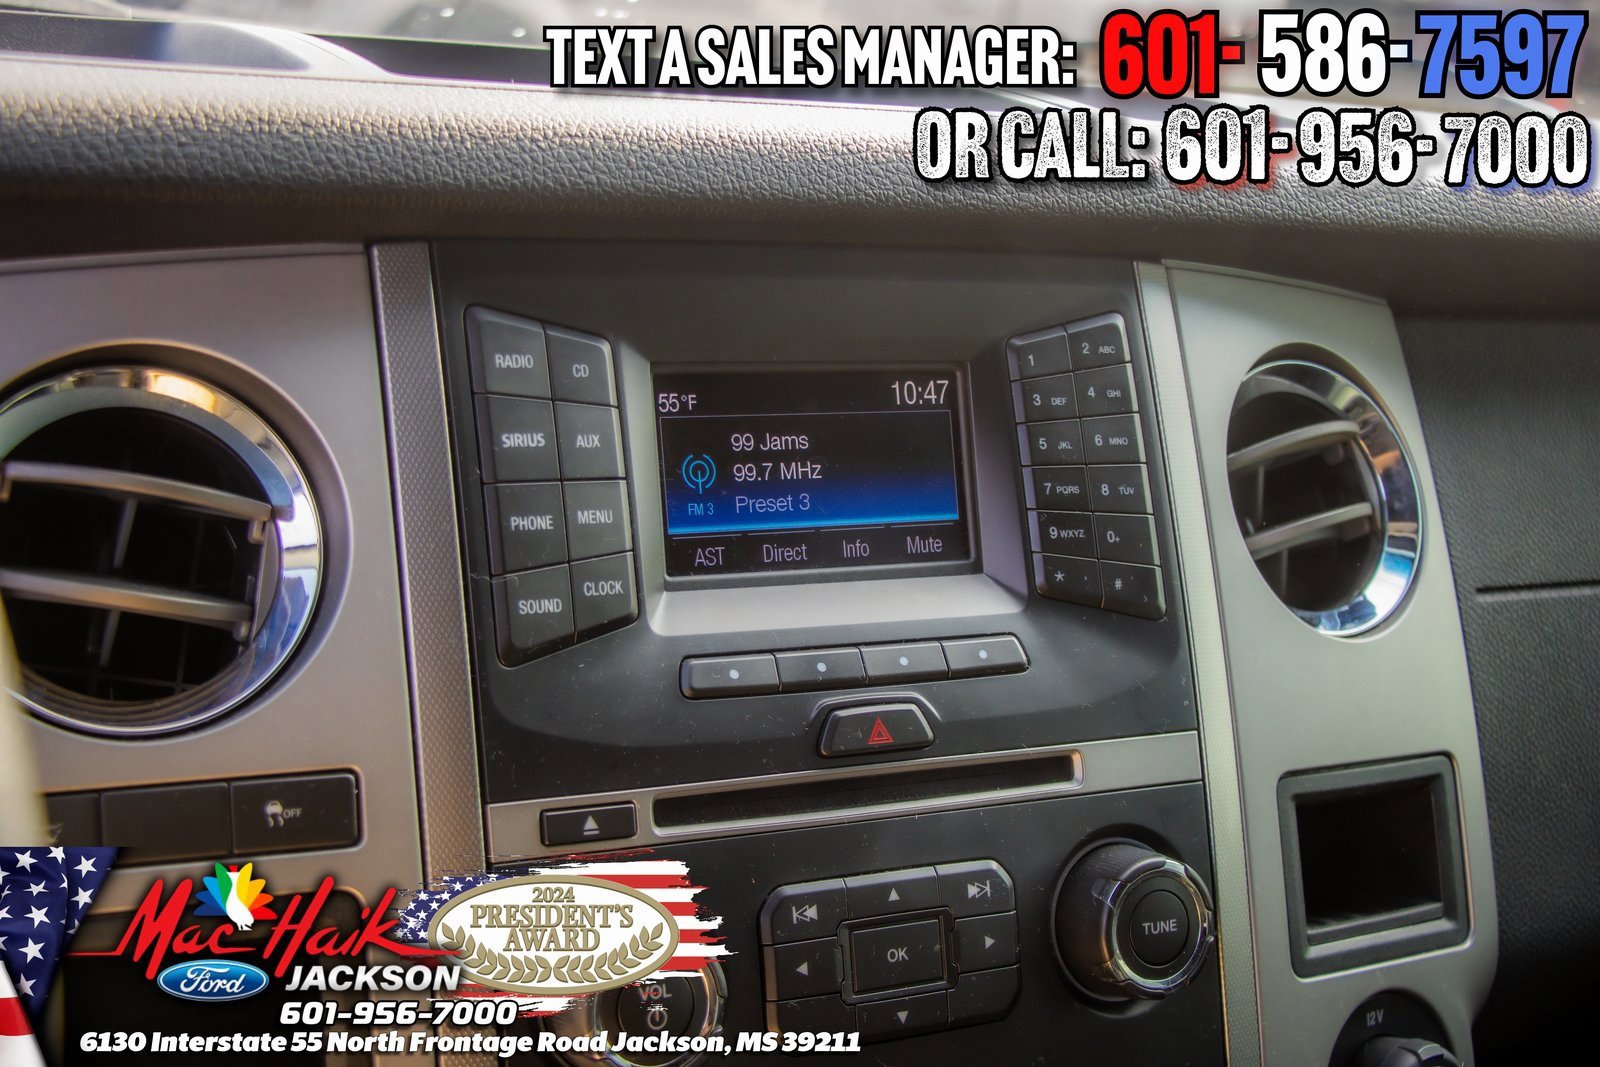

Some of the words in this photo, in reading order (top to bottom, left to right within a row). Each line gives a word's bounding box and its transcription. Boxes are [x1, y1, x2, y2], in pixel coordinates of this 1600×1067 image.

[1082, 342, 1090, 354] 2
[1098, 345, 1116, 354] ABC
[494, 352, 534, 370] RADIO
[1028, 355, 1035, 366] 1
[572, 364, 590, 379] CD
[891, 378, 950, 406] 10:47
[1032, 394, 1042, 406] 3
[1051, 396, 1068, 406] DEF
[1087, 386, 1096, 399] 4
[1106, 388, 1122, 398] GHI
[658, 392, 698, 413] 55°F
[501, 432, 546, 449] SIRIUS
[576, 434, 601, 449] AUX
[731, 433, 755, 453] 99
[759, 432, 810, 452] Jams
[1039, 438, 1048, 450] 5
[1058, 440, 1073, 450] JKL
[1094, 434, 1104, 447] 6
[1108, 436, 1129, 446] MNO
[733, 462, 773, 482] 99.7
[780, 461, 823, 481] MHz
[1044, 482, 1052, 495] 7
[1056, 485, 1080, 496] PQRS
[1100, 484, 1110, 496] 8
[1118, 486, 1135, 495] TUV
[688, 503, 705, 517] FM
[707, 502, 715, 516] 3
[735, 494, 794, 514] Preset
[798, 492, 811, 512] 3
[510, 516, 554, 532] PHONE
[576, 508, 614, 526] MENU
[1049, 526, 1058, 539] 9
[1059, 528, 1086, 538] WXYZ
[762, 542, 808, 563] Direct
[842, 538, 870, 560] Info
[906, 535, 944, 555] Mute
[694, 546, 725, 567] AST
[582, 580, 624, 597] CLOCK
[518, 598, 562, 615] SOUND
[282, 808, 303, 819] OFF
[1141, 917, 1179, 936] TUNE
[886, 945, 910, 963] OK
[639, 982, 672, 1000] VOL
[1366, 1008, 1384, 1027] 12V
